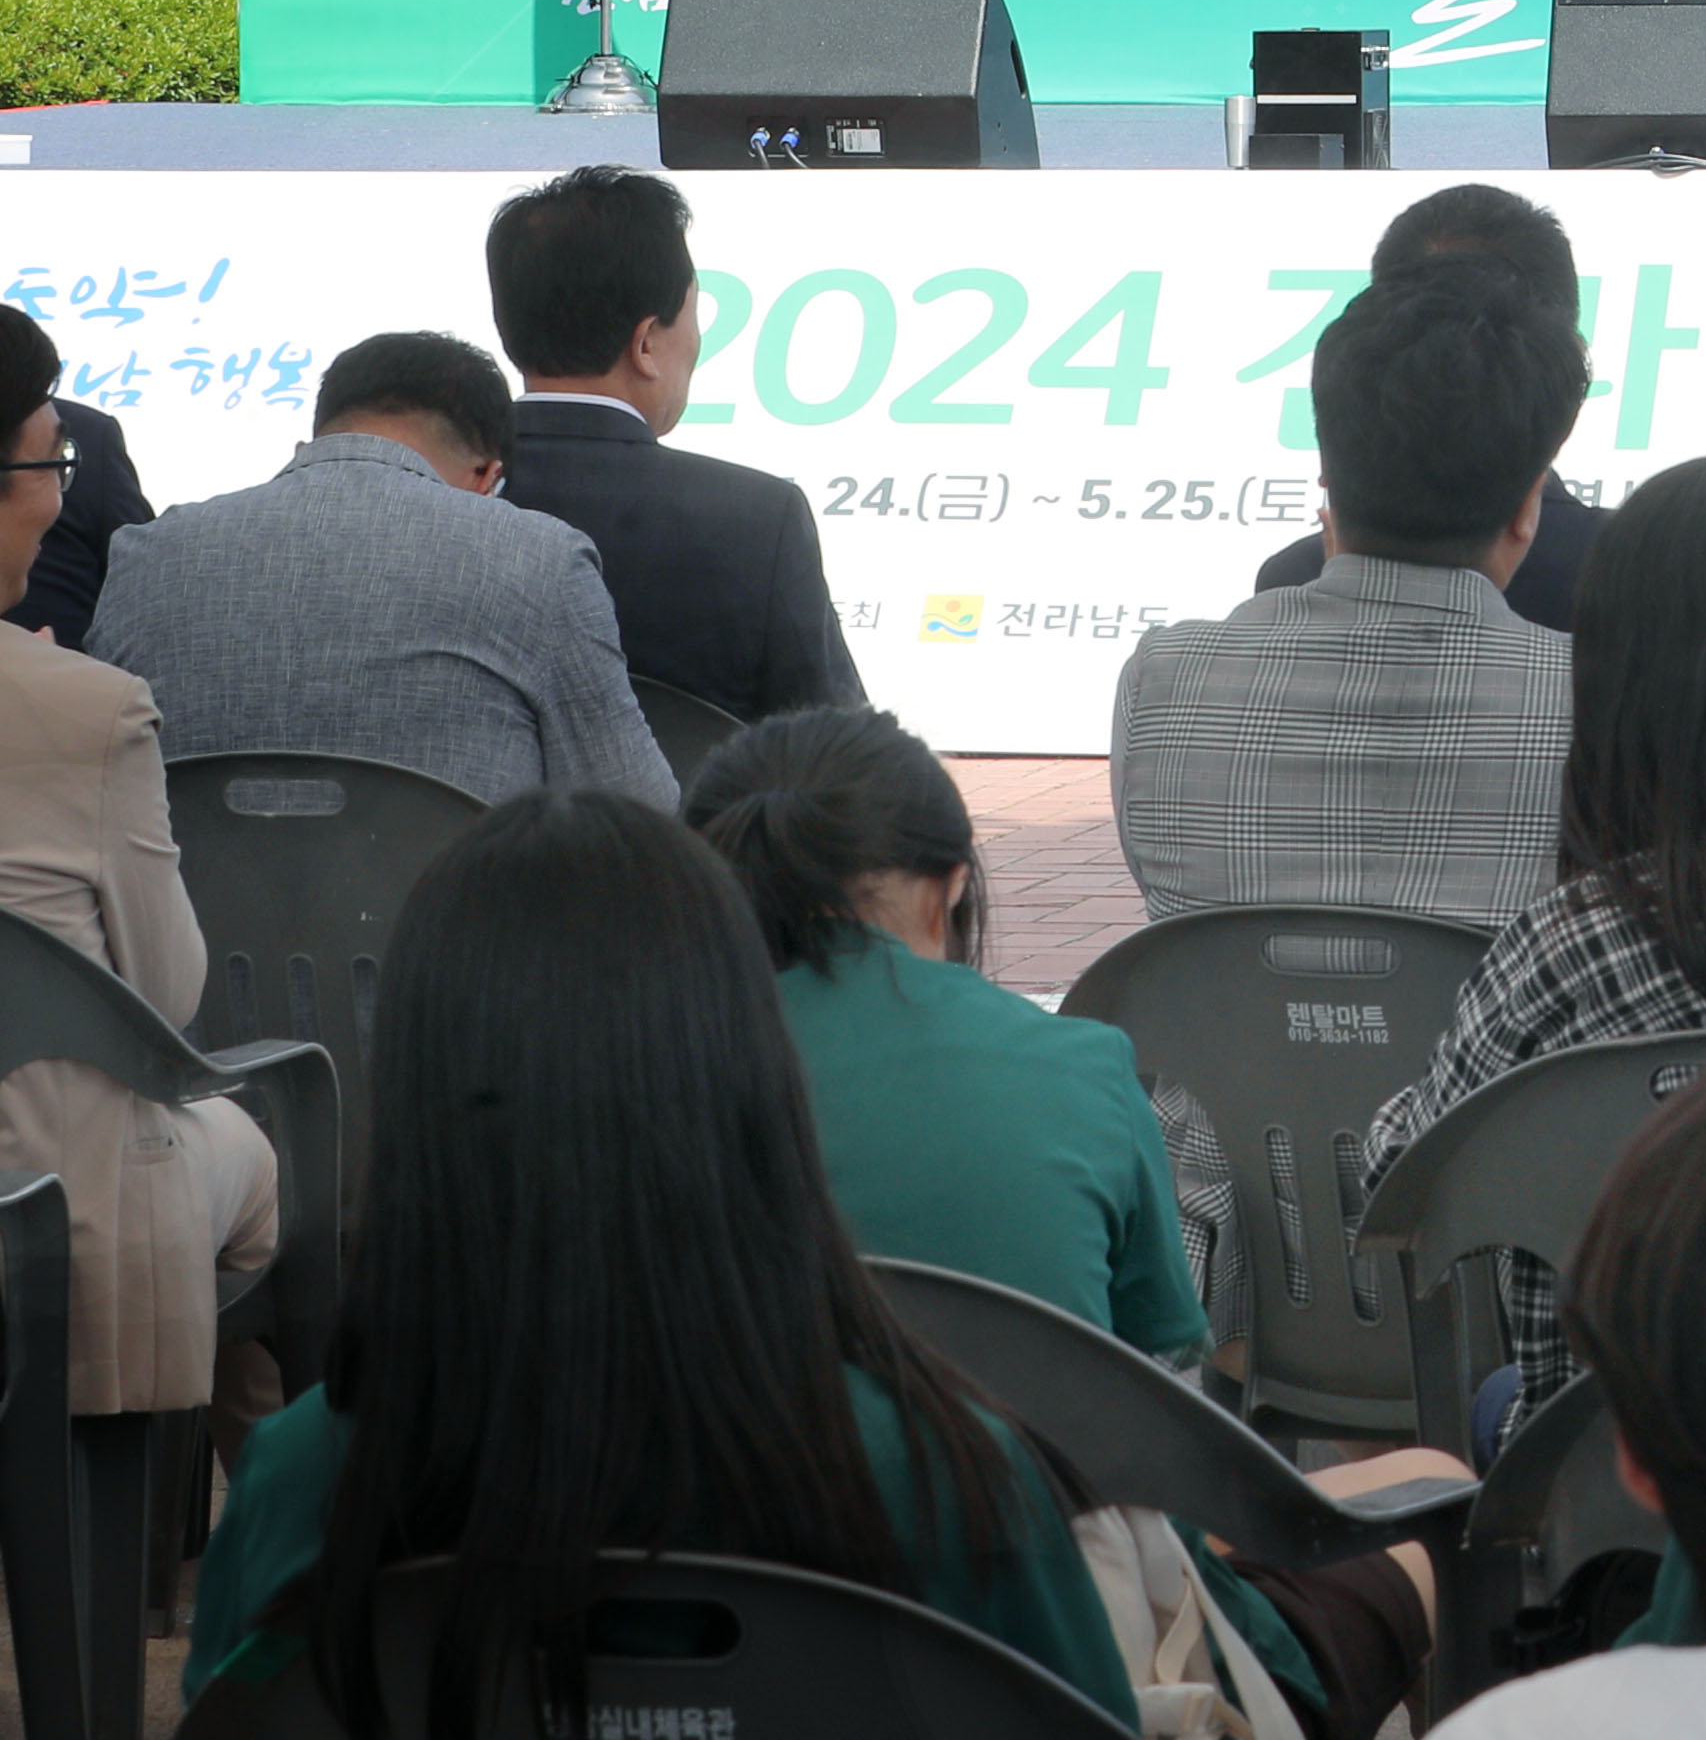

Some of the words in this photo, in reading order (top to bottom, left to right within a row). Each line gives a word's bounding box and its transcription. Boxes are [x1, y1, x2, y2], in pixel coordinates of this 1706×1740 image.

[57, 350, 152, 408] 남
[822, 472, 1010, 523] 24.(금)
[1286, 1002, 1387, 1030] 렌탈마트
[1288, 1026, 1389, 1044] 010-3634-1182
